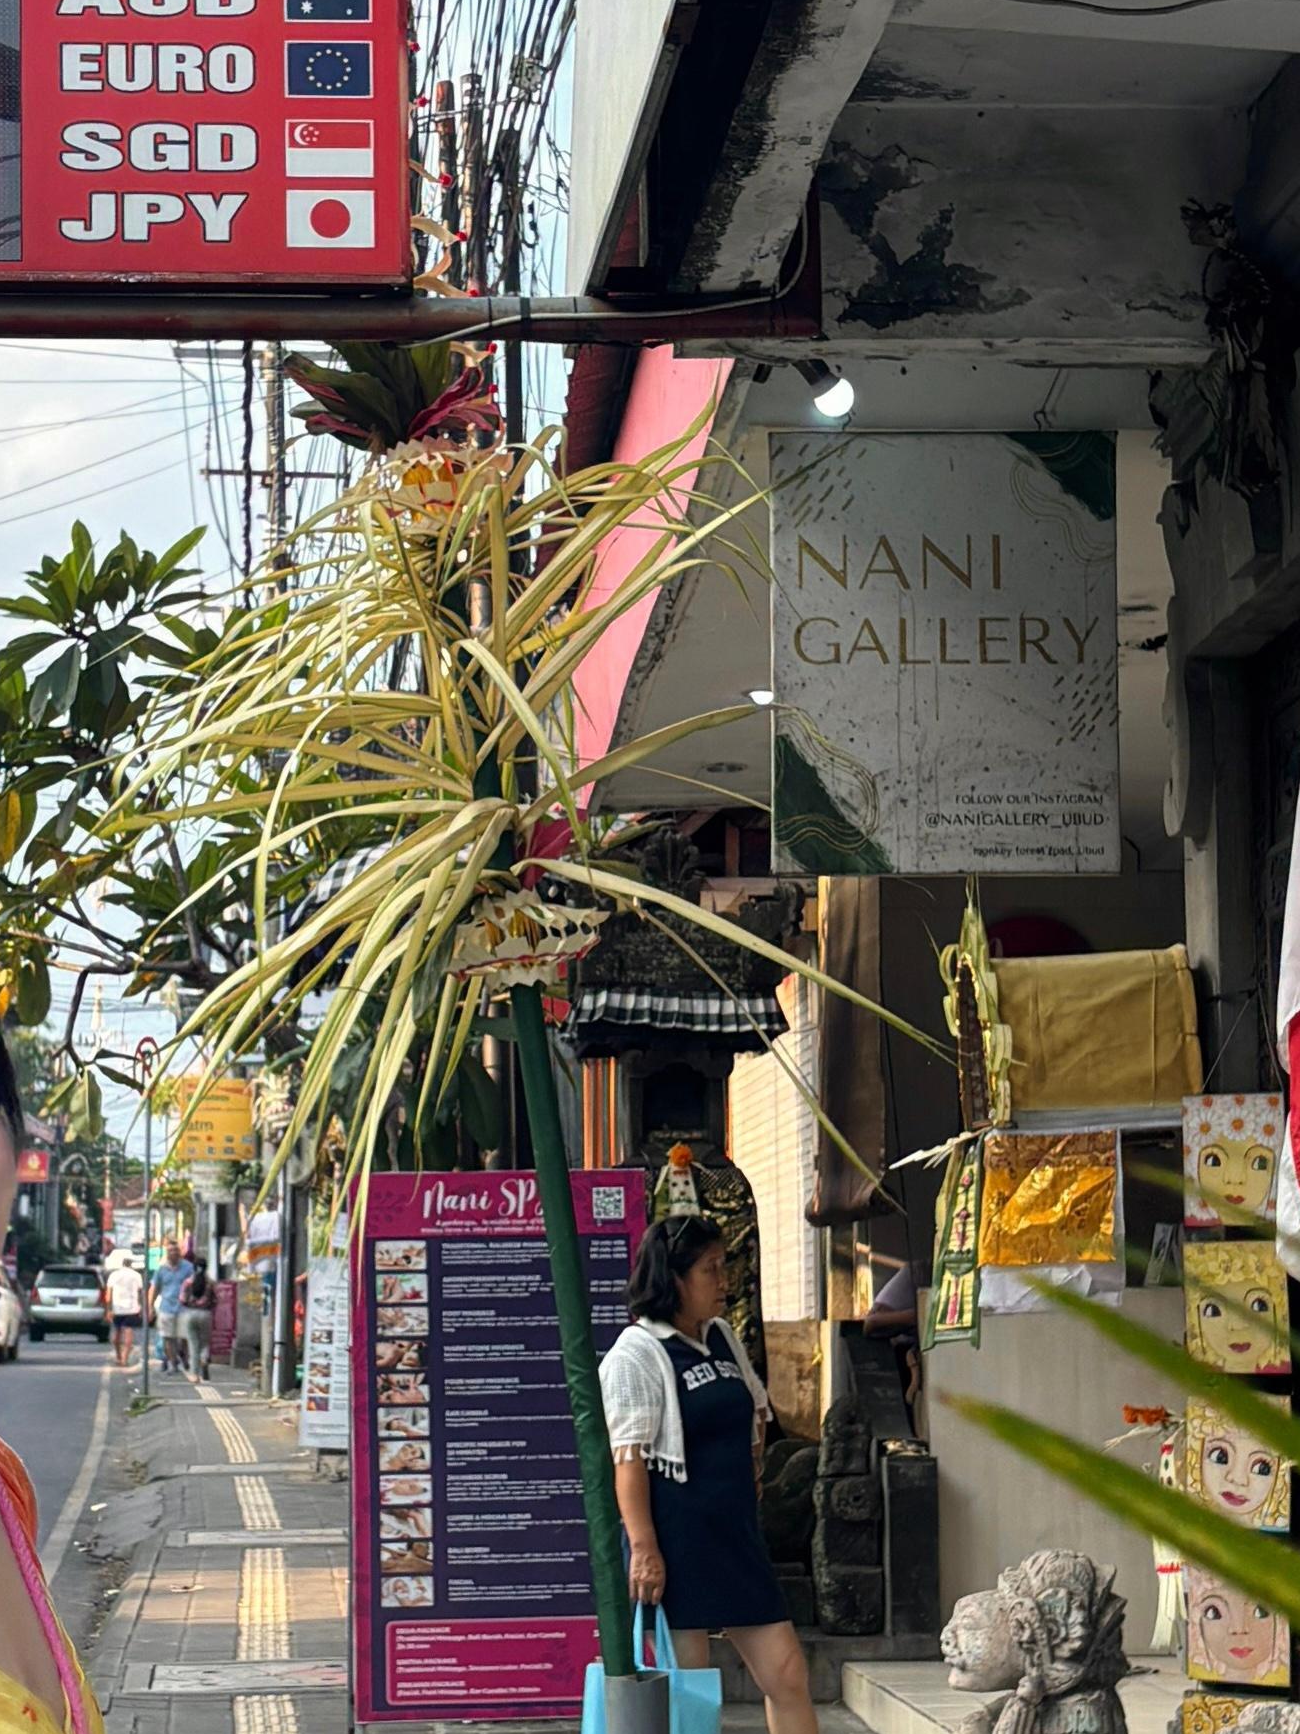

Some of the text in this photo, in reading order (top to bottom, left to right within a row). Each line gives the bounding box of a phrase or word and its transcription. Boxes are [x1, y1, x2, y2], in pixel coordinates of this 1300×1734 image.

[60, 42, 256, 93] EURO
[60, 122, 258, 173] SGD
[58, 191, 251, 243] JPY
[797, 533, 1002, 590] NANI
[793, 615, 1099, 665] GALLERY
[423, 1180, 492, 1219] Nani
